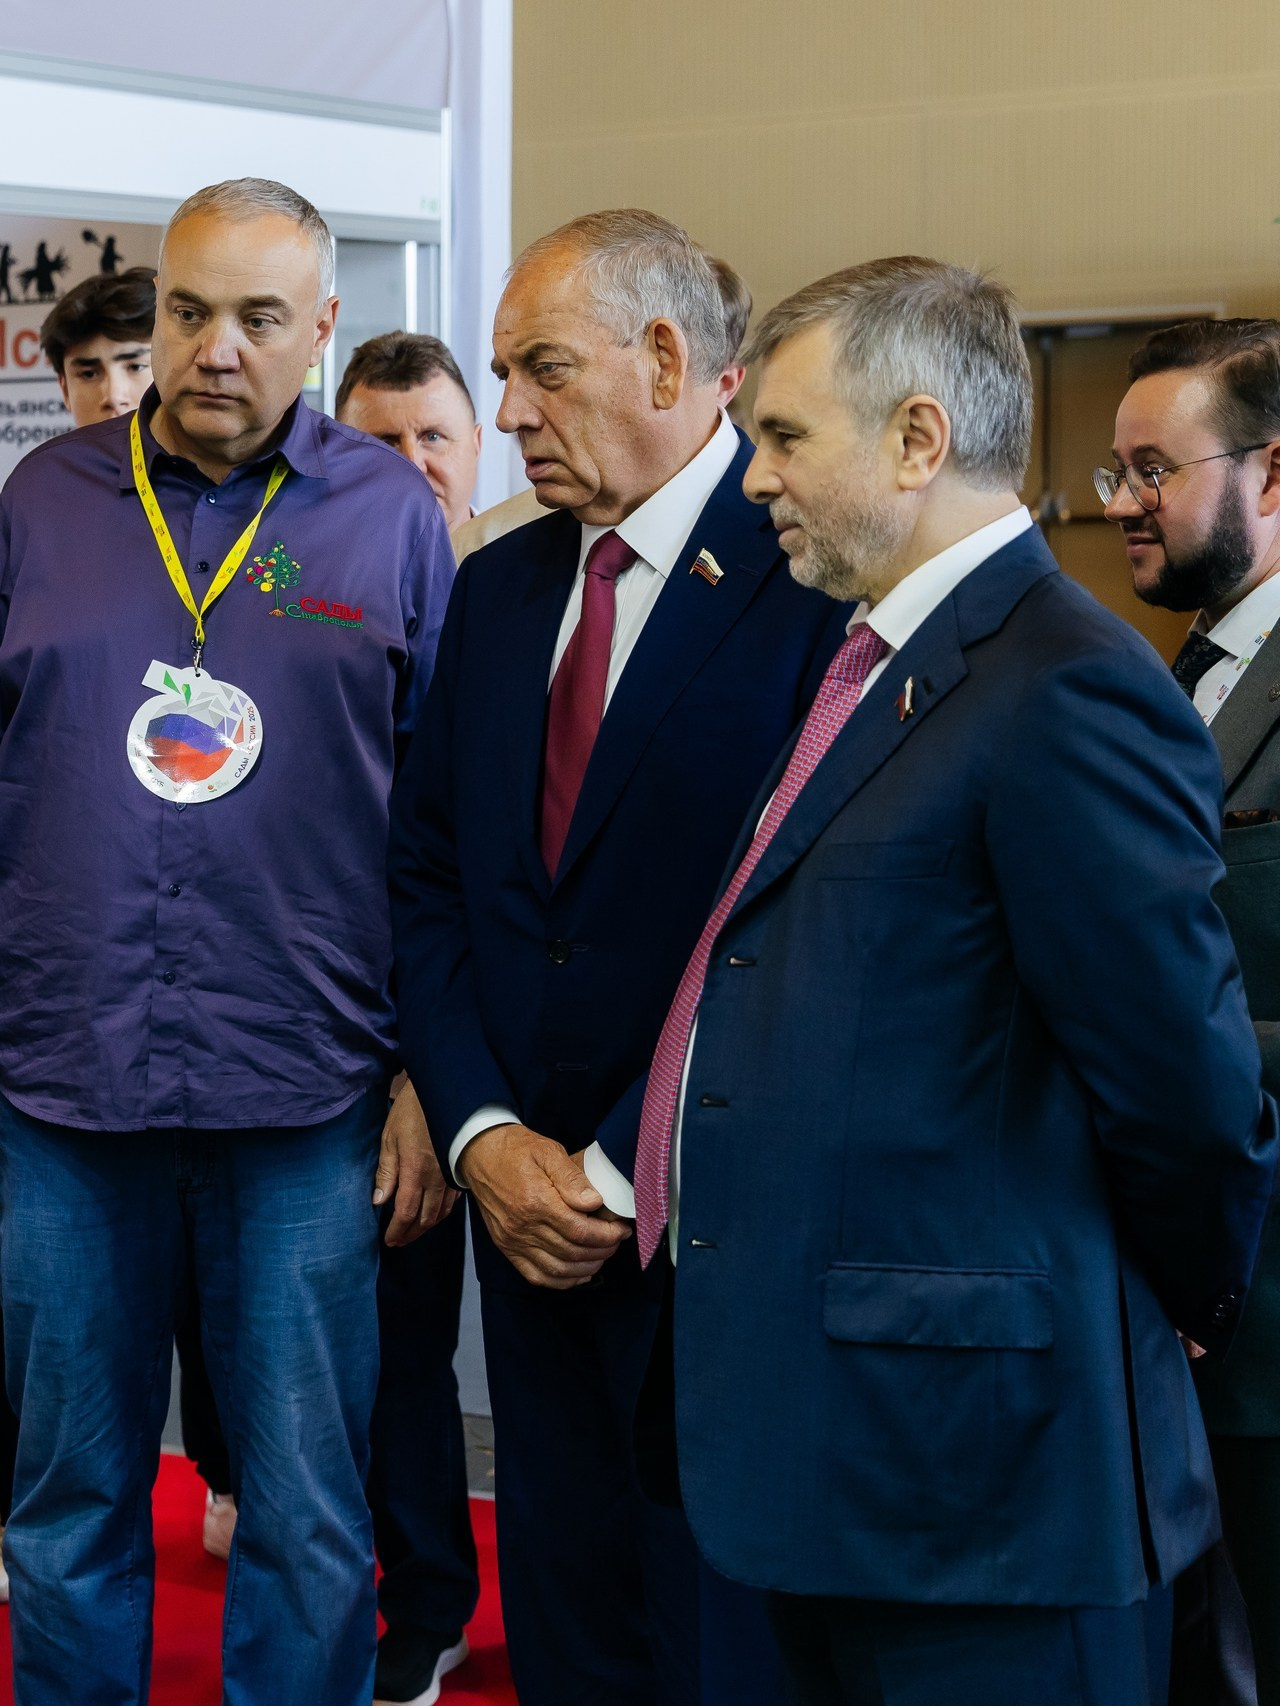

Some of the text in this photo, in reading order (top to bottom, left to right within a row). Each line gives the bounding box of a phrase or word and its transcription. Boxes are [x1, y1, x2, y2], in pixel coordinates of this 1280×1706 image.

[301, 597, 363, 621] САДЫ
[234, 757, 250, 778] САДЫ
[247, 705, 256, 722] 2025
